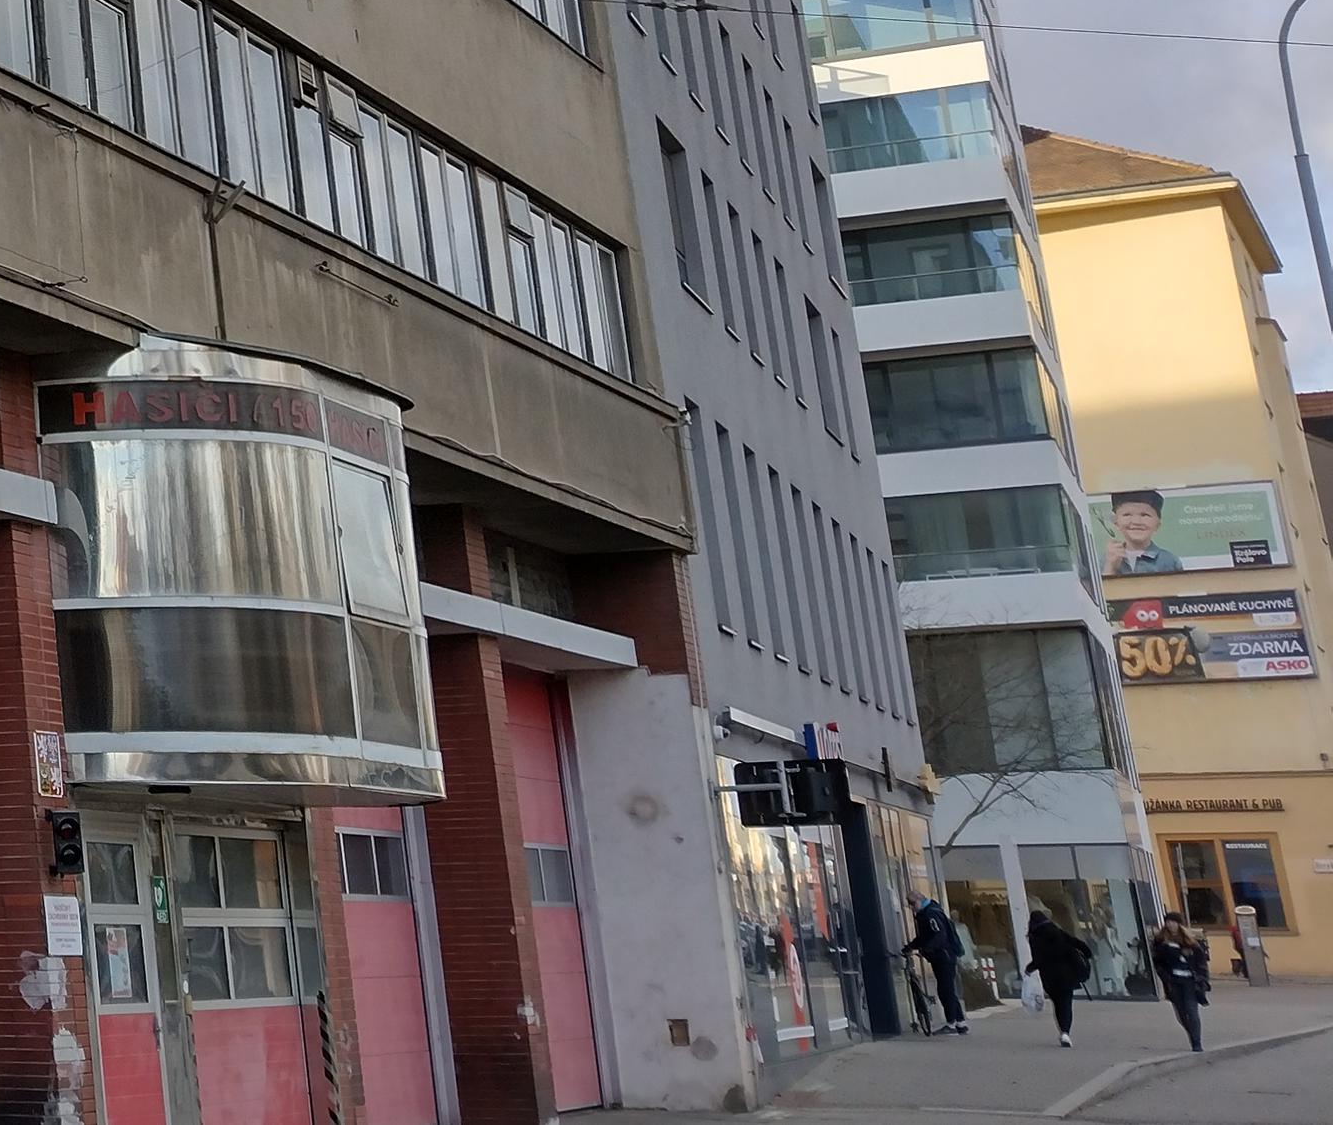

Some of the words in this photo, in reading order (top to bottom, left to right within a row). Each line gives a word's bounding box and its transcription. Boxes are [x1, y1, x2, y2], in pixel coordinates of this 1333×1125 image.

[72, 381, 238, 425] HASIČI
[272, 394, 318, 434] 150
[1169, 601, 1237, 614] PLÁNOVANÉ
[1228, 640, 1304, 655] ZDARMA
[1265, 660, 1309, 671] ASKO
[1186, 798, 1248, 810] RESTAURANT
[1252, 799, 1259, 809] &
[1263, 798, 1283, 809] PUB
